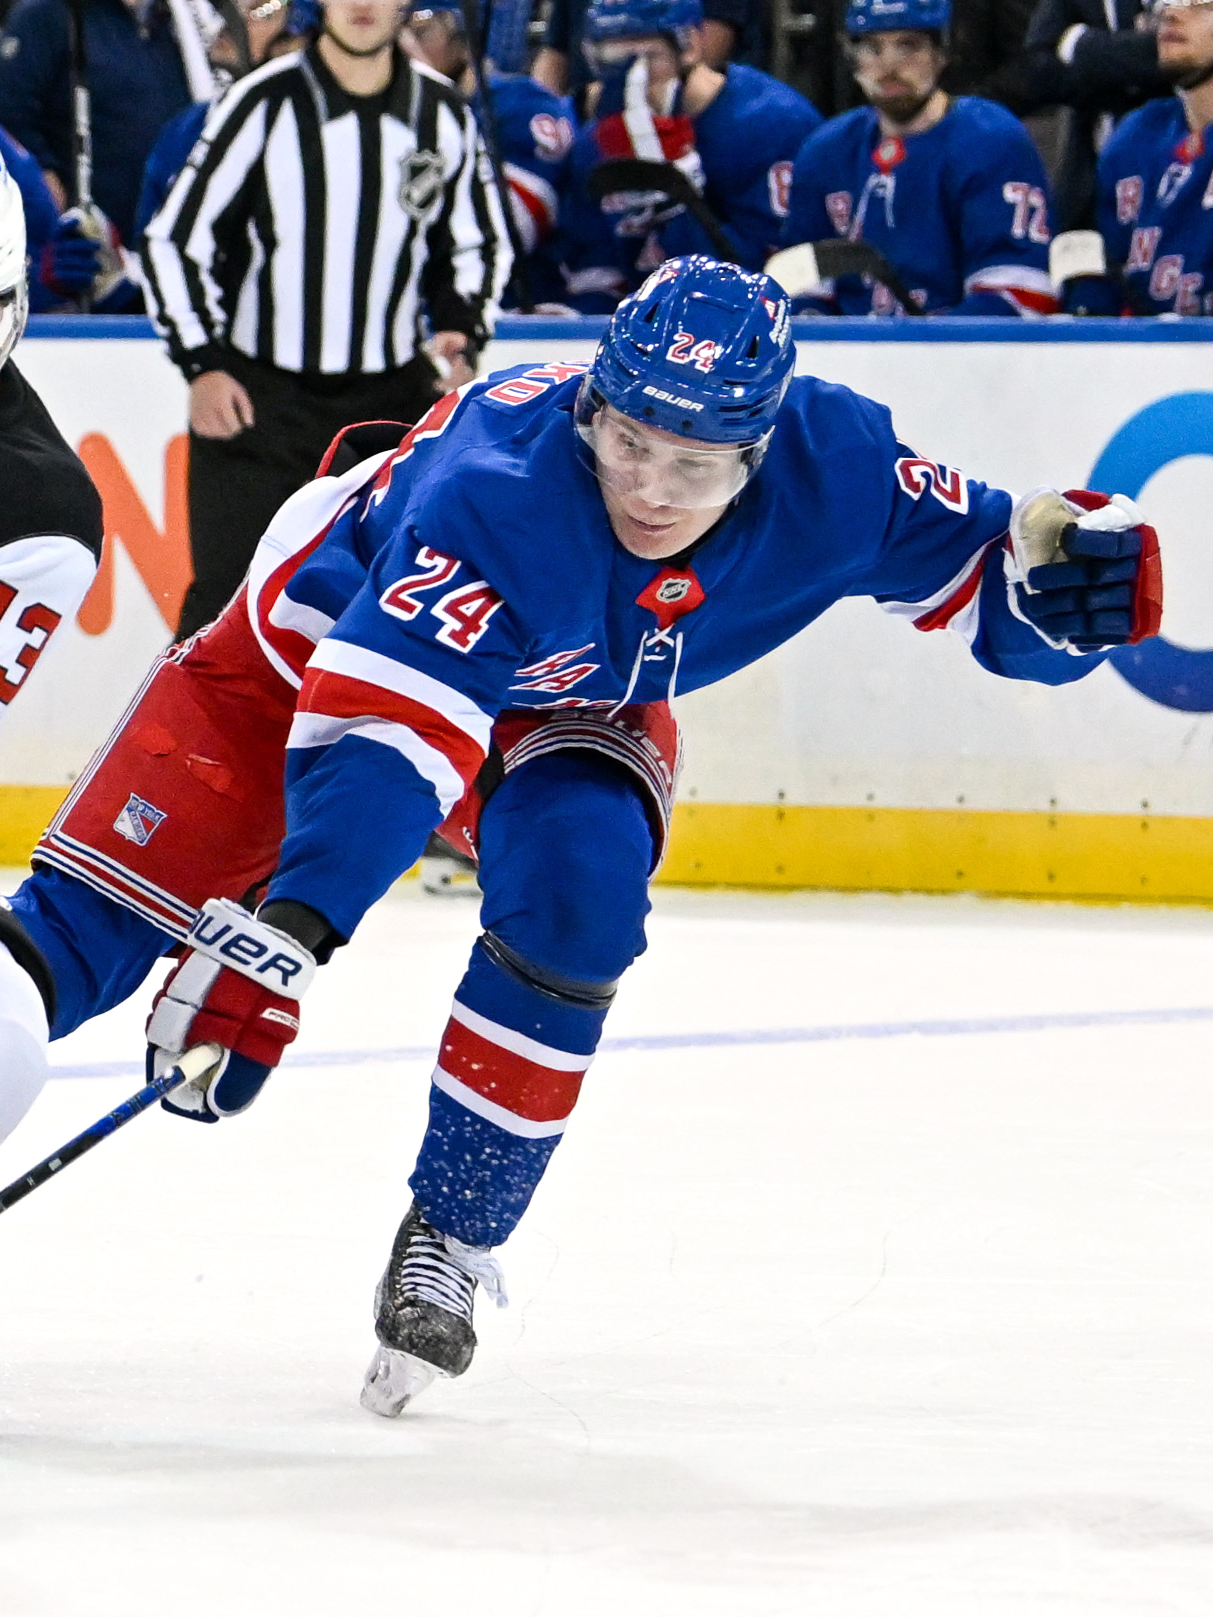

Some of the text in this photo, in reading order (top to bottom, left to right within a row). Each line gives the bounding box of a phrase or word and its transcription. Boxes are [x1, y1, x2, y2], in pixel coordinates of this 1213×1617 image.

[1002, 181, 1050, 244] 72
[665, 332, 717, 374] 24
[894, 440, 969, 516] 2
[378, 545, 504, 654] 24
[189, 909, 303, 988] UER
